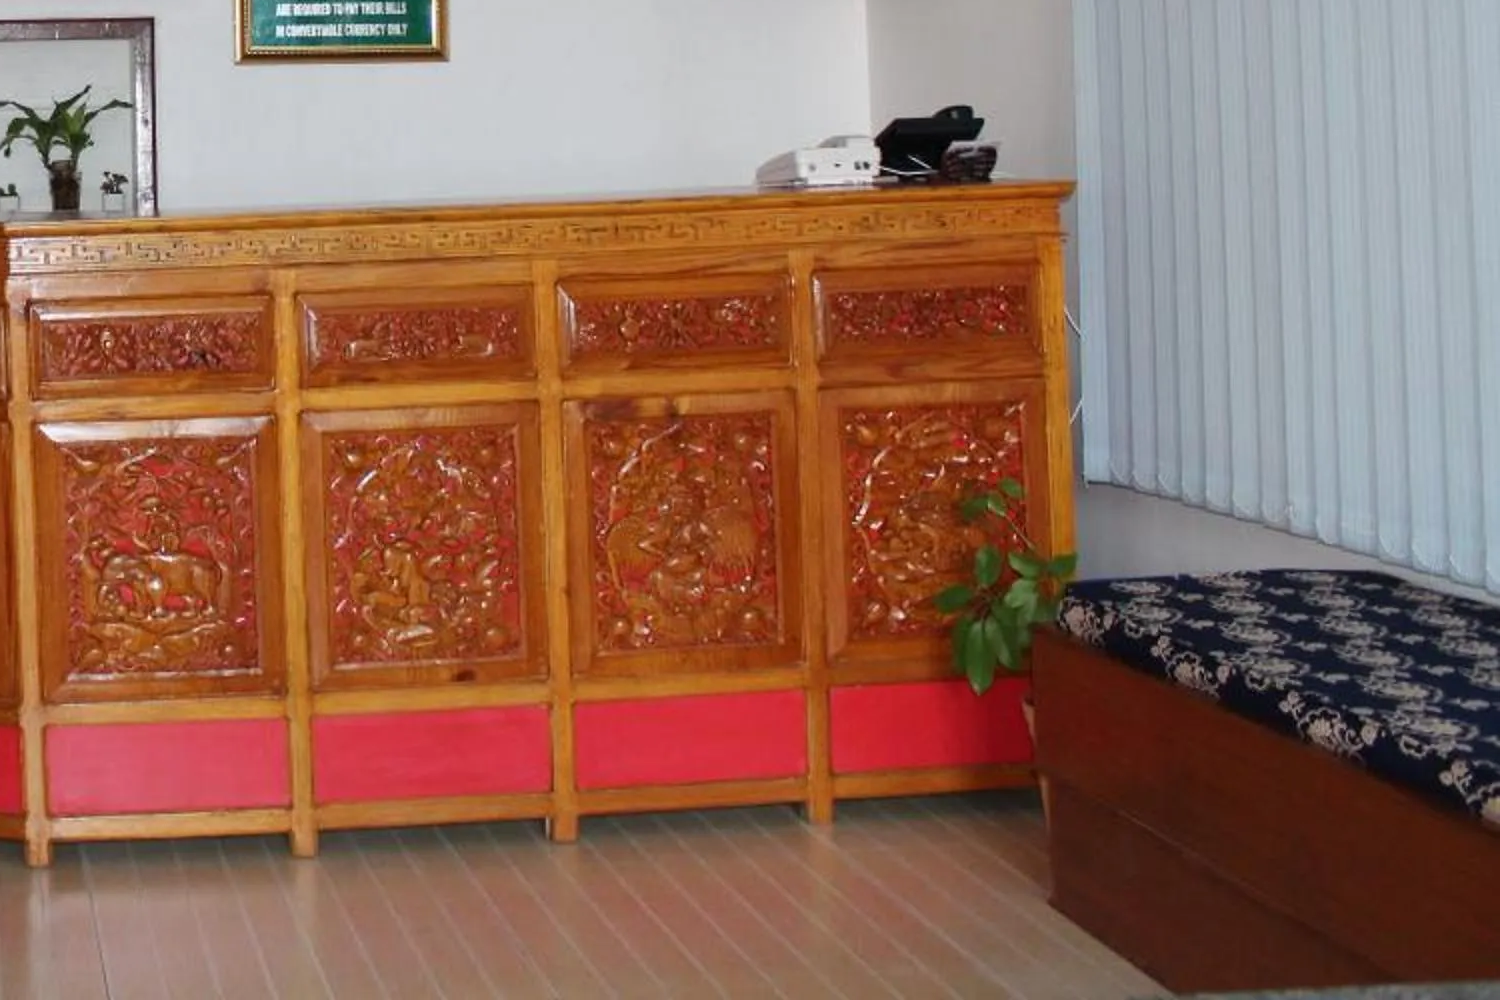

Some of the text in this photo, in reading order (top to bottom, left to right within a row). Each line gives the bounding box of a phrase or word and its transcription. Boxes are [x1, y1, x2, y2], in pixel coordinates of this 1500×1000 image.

[276, 3, 290, 16] ARE
[333, 3, 344, 15] TO
[345, 2, 358, 15] PAY
